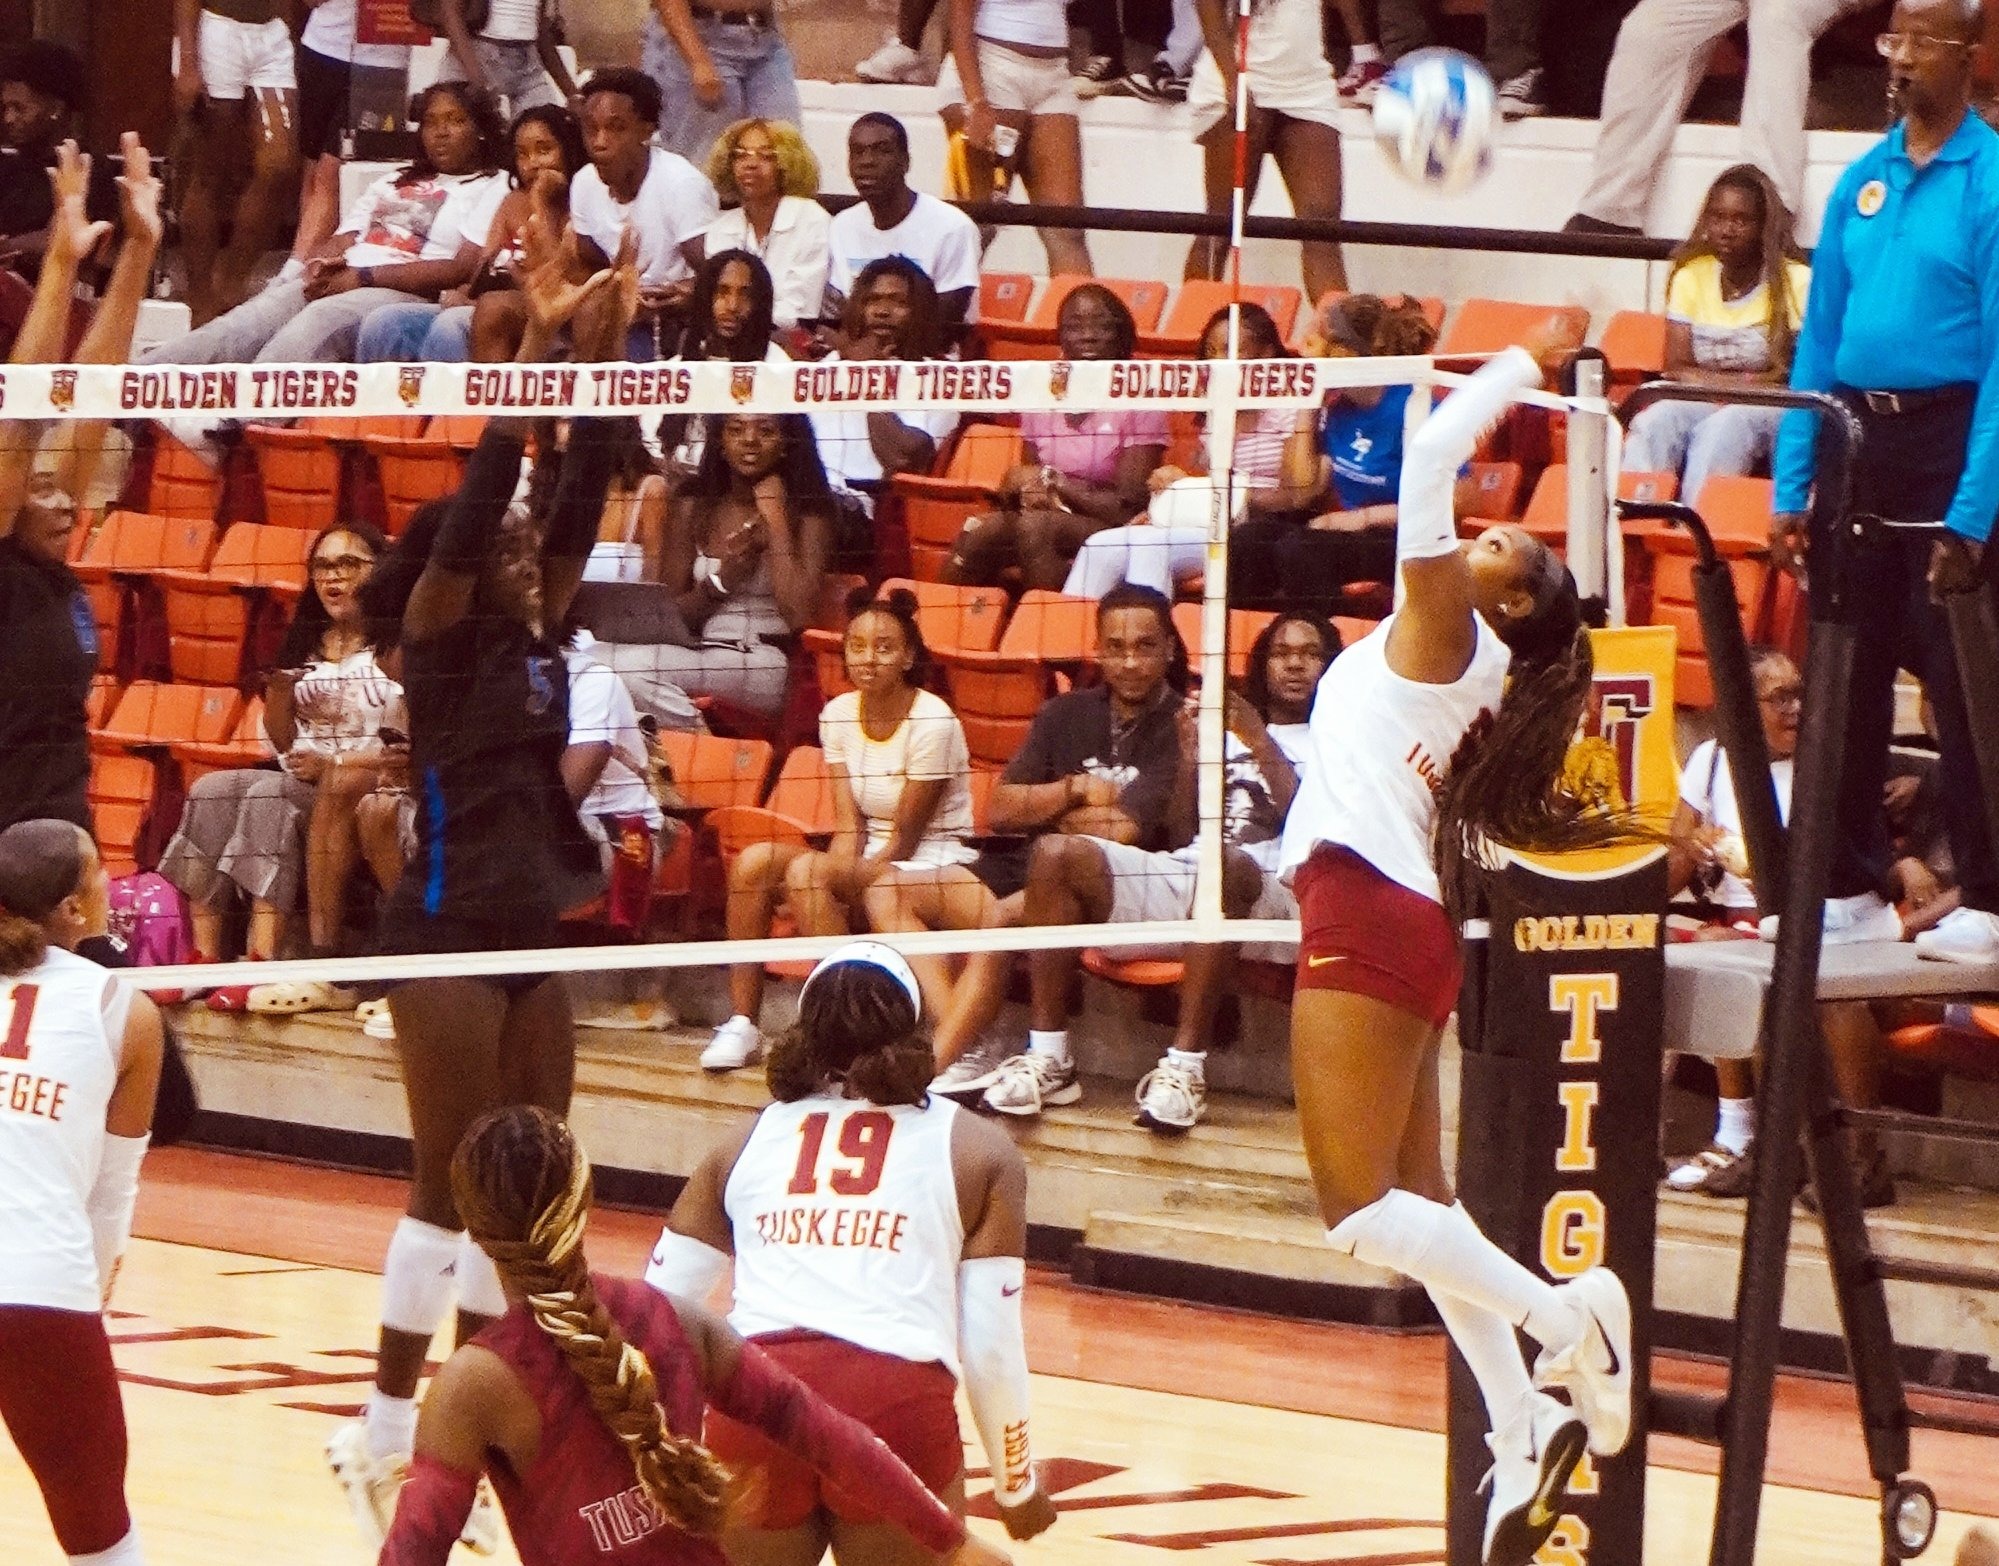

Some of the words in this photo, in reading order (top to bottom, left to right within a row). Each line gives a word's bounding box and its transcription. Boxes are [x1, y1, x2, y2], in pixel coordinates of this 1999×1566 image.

[121, 371, 238, 409] GOLDEN
[251, 370, 360, 408] TIGERS
[464, 368, 578, 406] GOLDEN
[591, 368, 693, 406] TIGERS
[794, 366, 899, 402] GOLDEN
[915, 365, 1012, 400] TIGERS
[1109, 363, 1212, 398] GOLDEN
[1238, 362, 1318, 397] IGERS
[526, 655, 552, 715] 5
[1513, 913, 1660, 952] GOLDEN
[0, 983, 39, 1060] 1
[787, 1110, 895, 1196] 19
[756, 1208, 908, 1253] TUSKEGEE
